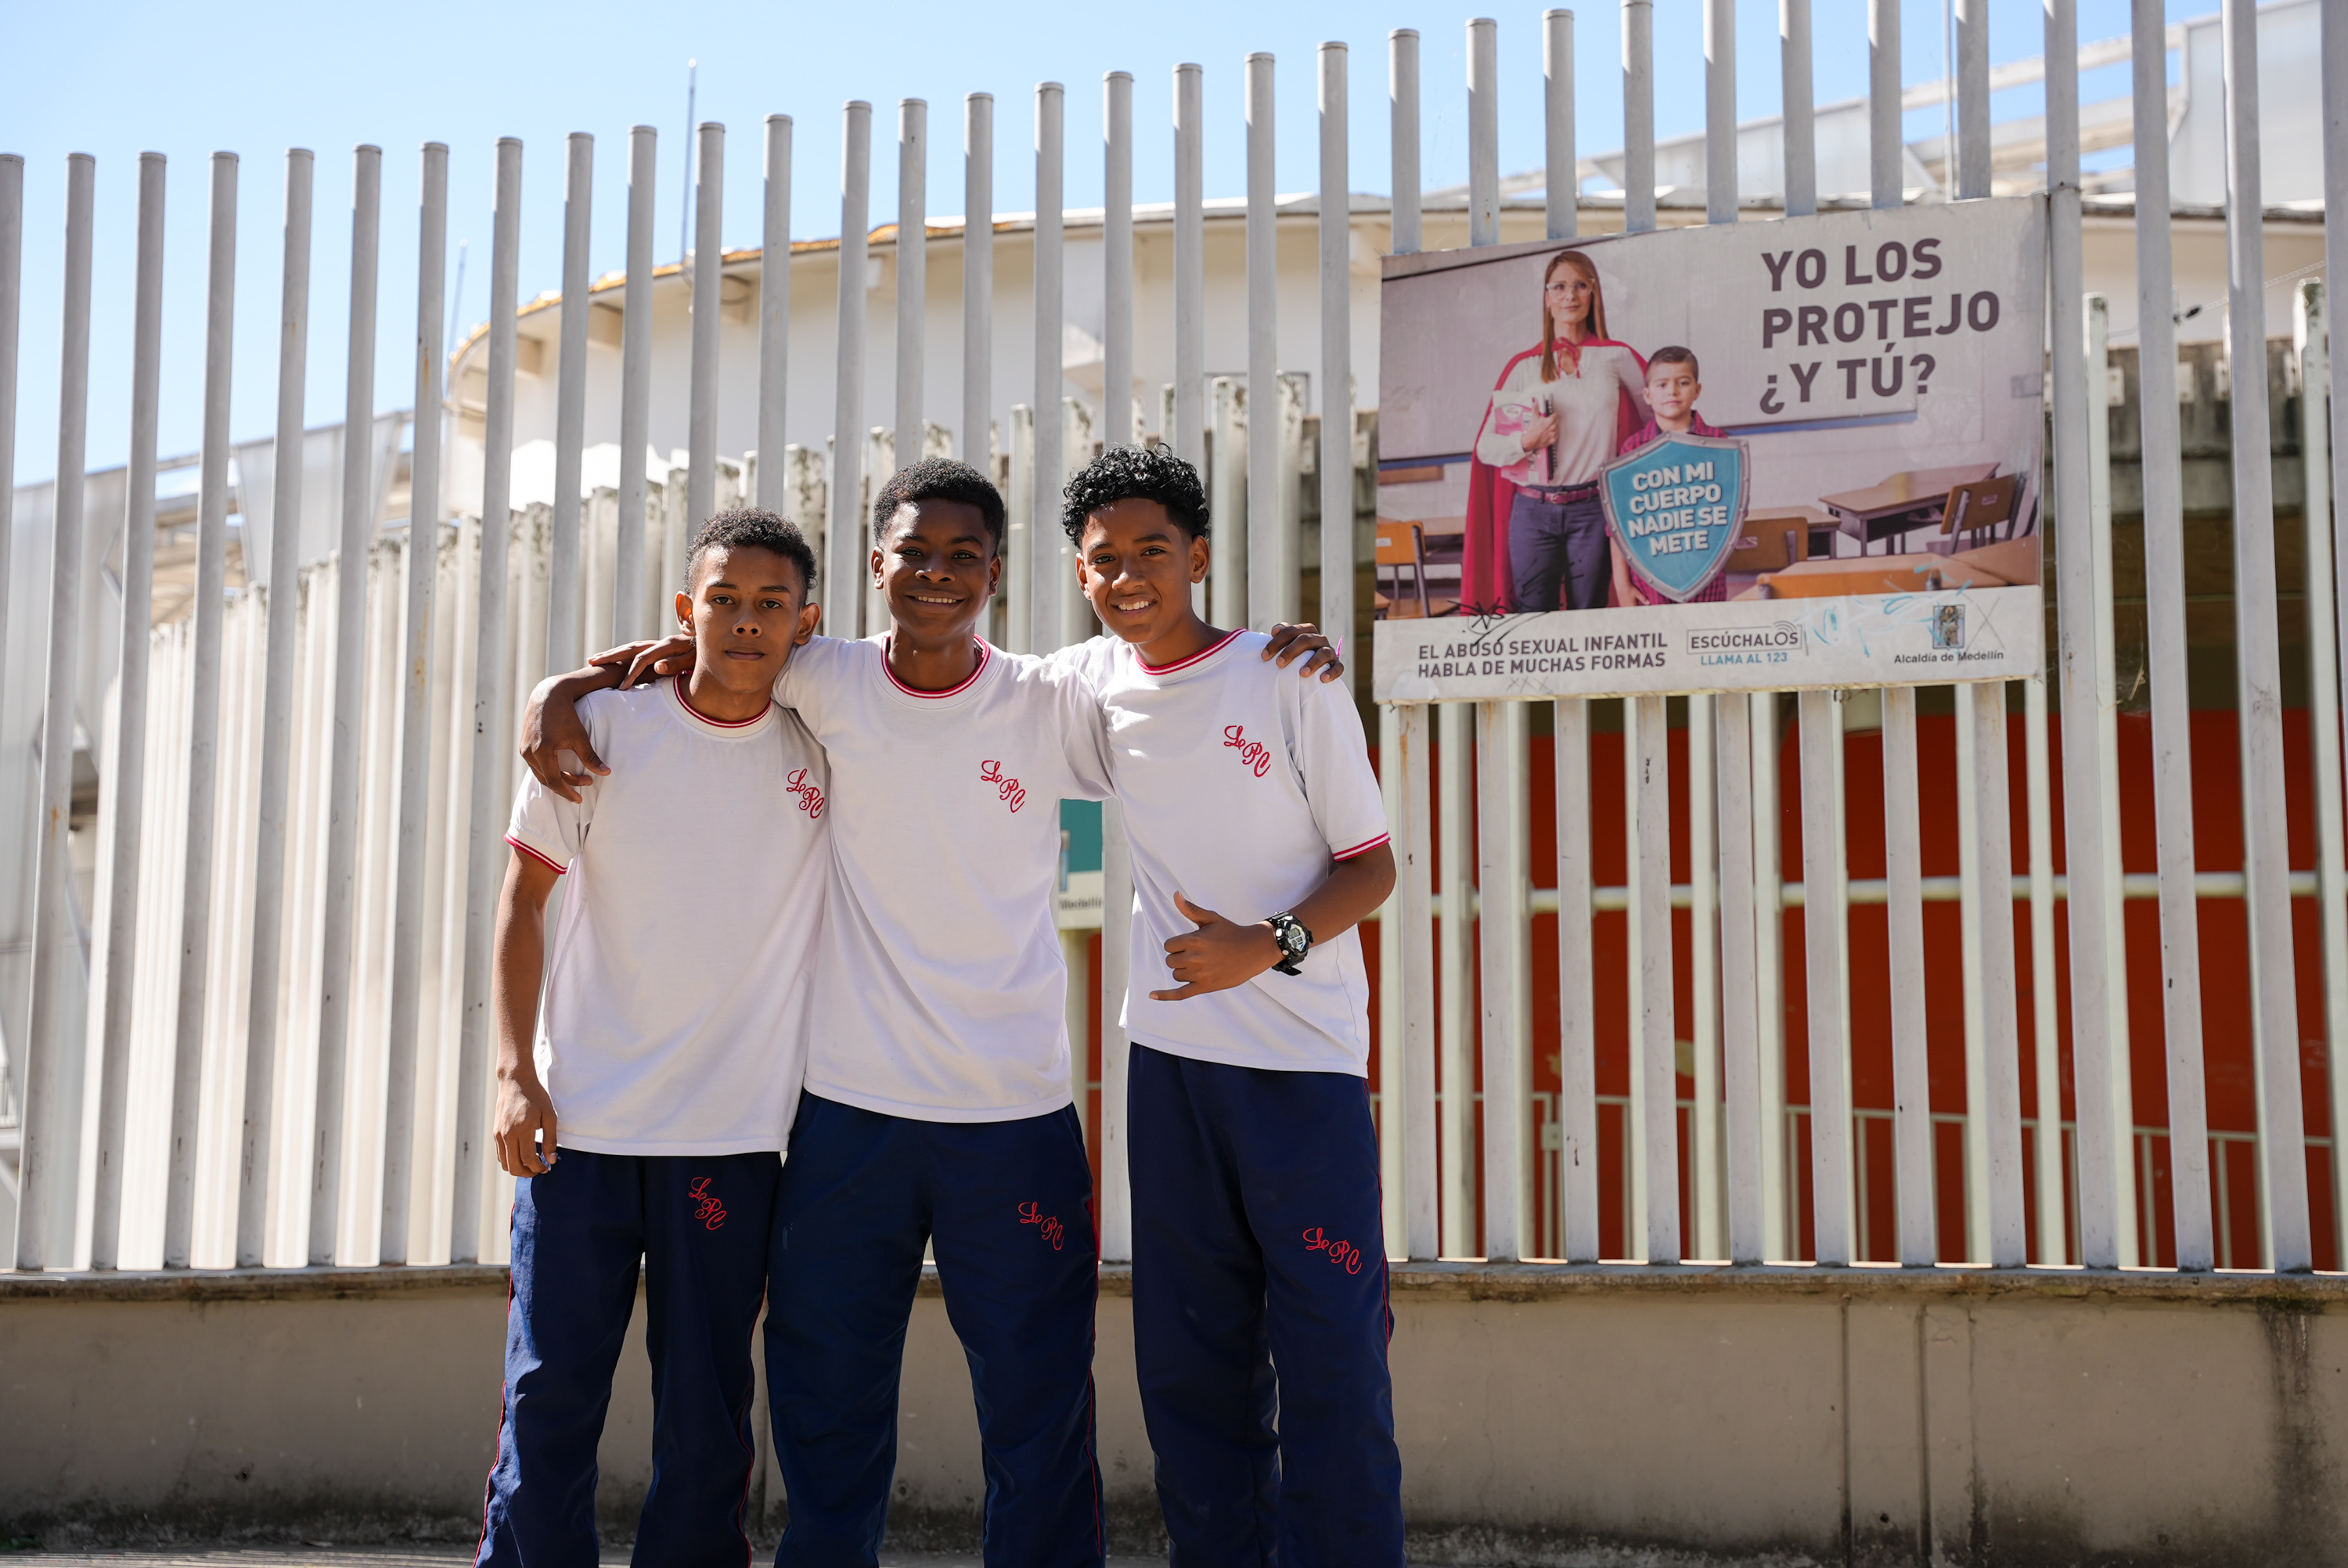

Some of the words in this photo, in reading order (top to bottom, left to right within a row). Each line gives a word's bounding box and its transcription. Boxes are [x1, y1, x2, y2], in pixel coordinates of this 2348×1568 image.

[1761, 248, 1827, 292] YO
[1845, 238, 1943, 286] LOS
[1763, 290, 2000, 349] PROTEJO
[1759, 361, 1823, 415] ¿Y
[1836, 342, 1936, 400] TÚ?
[1633, 466, 1681, 492] CON
[1685, 461, 1715, 483] MI
[1630, 484, 1722, 515] CUERPO
[1628, 509, 1695, 538] NADIE
[1698, 505, 1728, 527] SE
[1650, 530, 1709, 556] METE
[1418, 645, 1439, 660] EL
[1444, 642, 1504, 659] ABUSO
[1509, 638, 1579, 656] SEXUAL
[1584, 632, 1668, 652] INFANTIL
[1691, 631, 1799, 649] ESCÚCHALOS
[1418, 661, 1477, 678] HABLA
[1482, 660, 1505, 675] DE
[1511, 656, 1586, 674] MUCHAS
[1591, 652, 1666, 671] FORMAS
[1701, 654, 1743, 666] LLAMA
[1746, 653, 1763, 664] AL
[1766, 652, 1788, 663] 123
[1894, 653, 1937, 664] Alcaldía
[1941, 653, 1954, 662] de
[1958, 650, 2004, 662] Medellín
